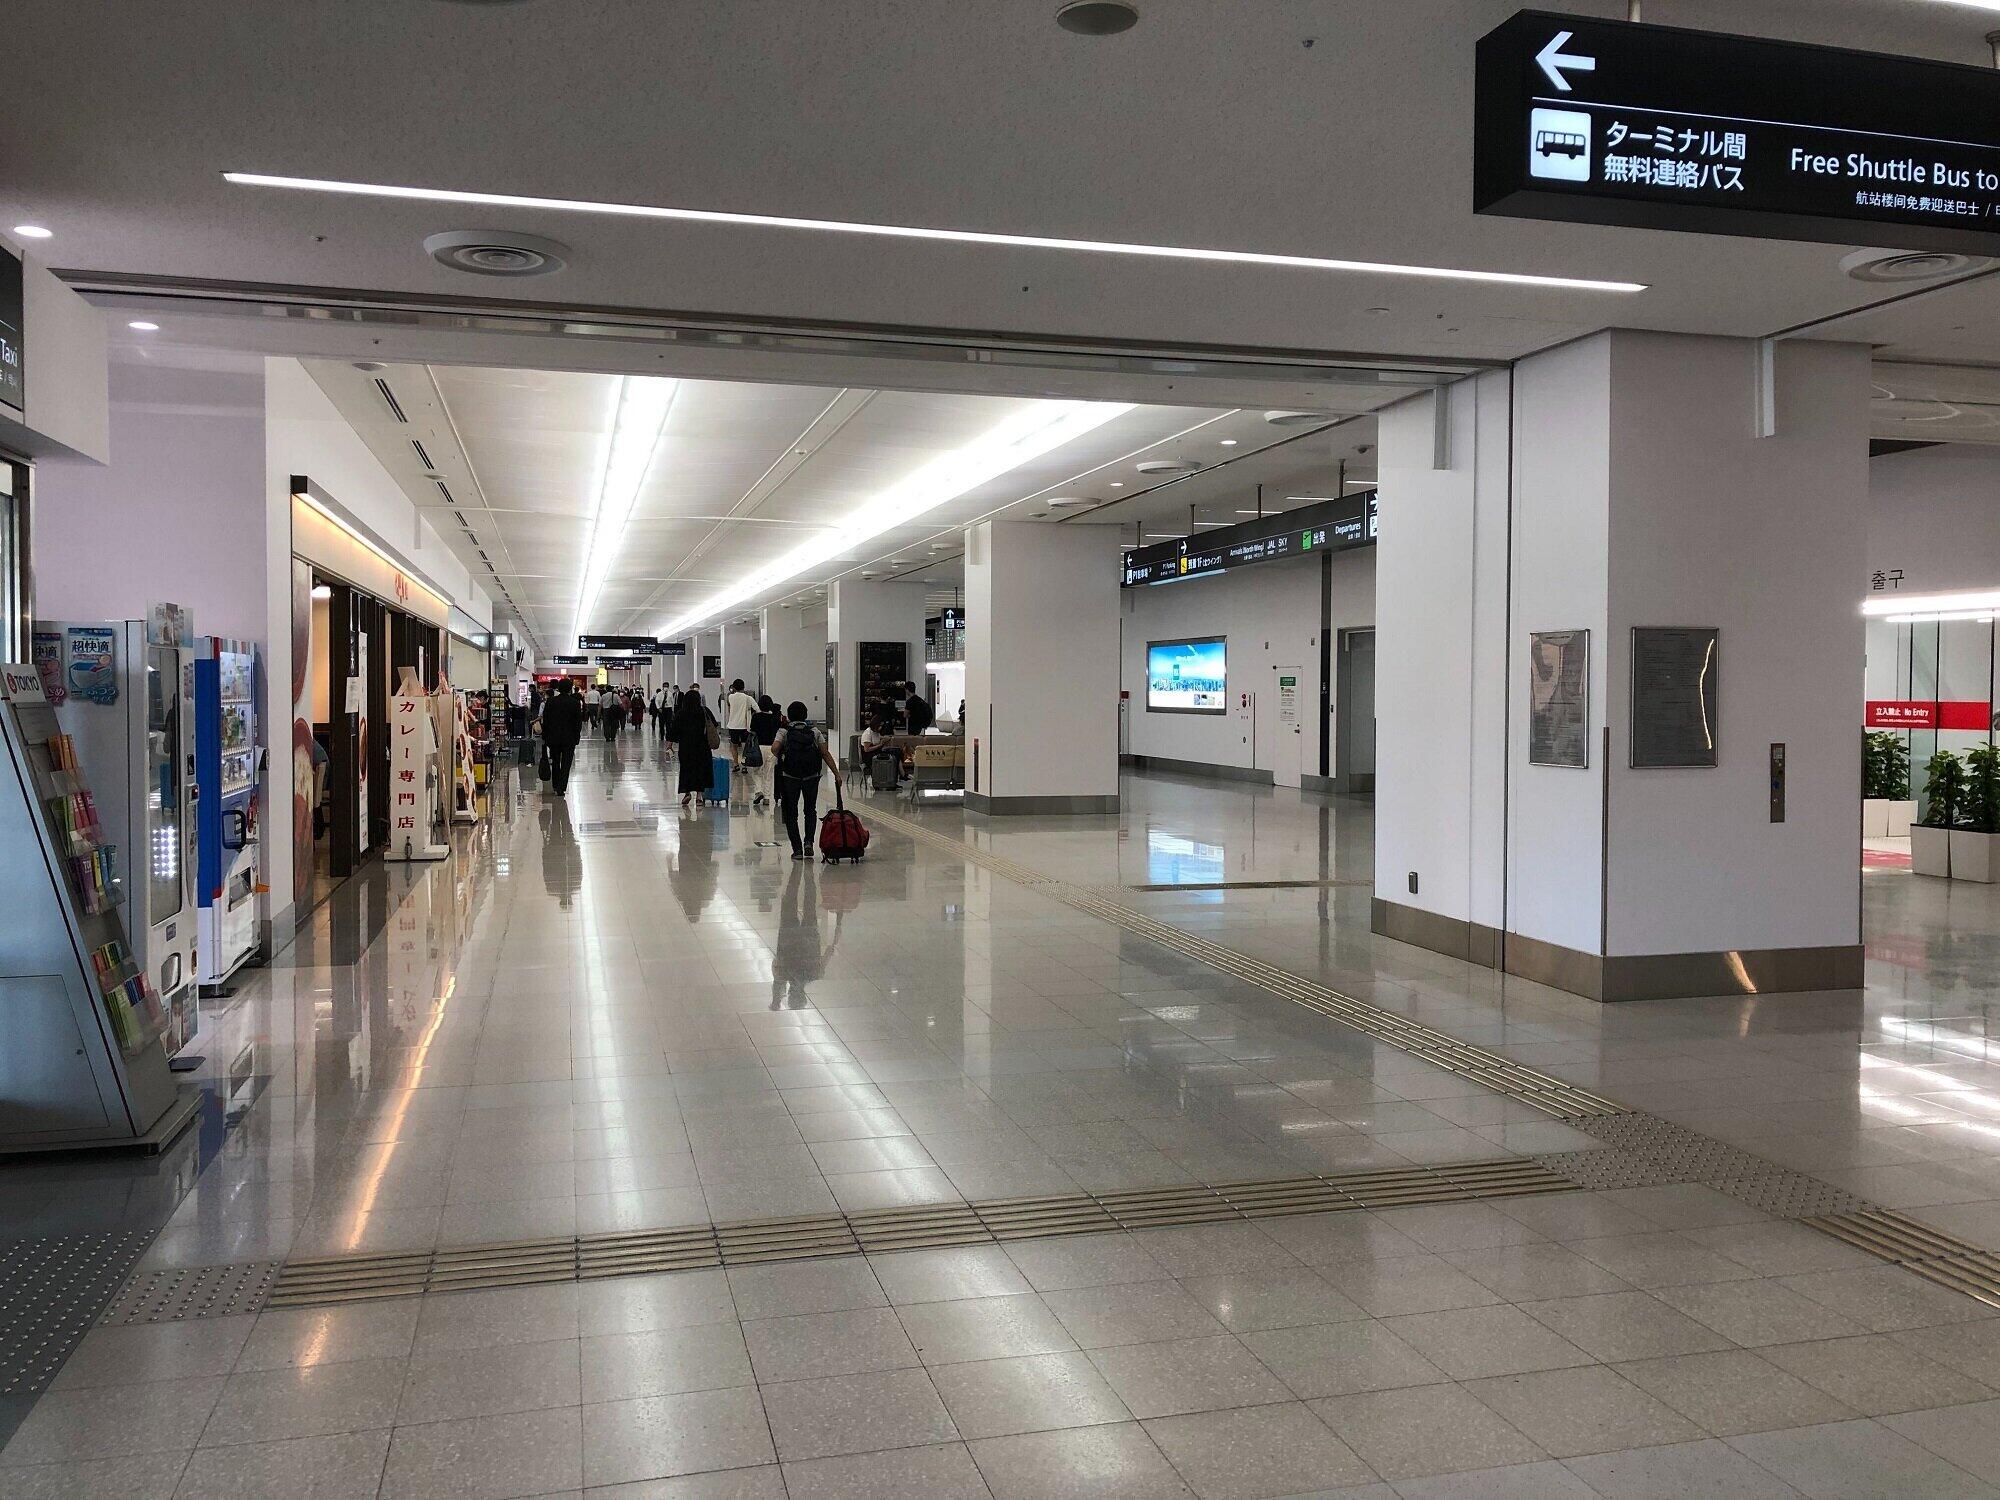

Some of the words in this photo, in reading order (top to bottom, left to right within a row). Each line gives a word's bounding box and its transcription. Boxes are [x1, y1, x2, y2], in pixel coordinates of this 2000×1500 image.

[1606, 120, 1746, 160] ターミナル間
[1604, 153, 1745, 191] 無料連絡バス
[1791, 147, 1840, 175] Free
[1847, 153, 1926, 183] Shuttle
[1933, 162, 1970, 188] Bus
[1976, 169, 1999, 191] to
[1855, 190, 1980, 216] 航站楼间免费迎送巴士
[0, 338, 18, 368] Taxi
[1313, 530, 1326, 544] 出発
[1335, 522, 1361, 535] Departures
[1267, 540, 1276, 549] JAL
[1278, 537, 1288, 547] SKY
[1872, 569, 1905, 590] 출구
[72, 640, 111, 653] 超快適
[14, 675, 40, 691] TOKYO
[1904, 707, 1912, 716] No
[1912, 707, 1930, 717] Entry
[397, 701, 415, 829] カレー専門店
